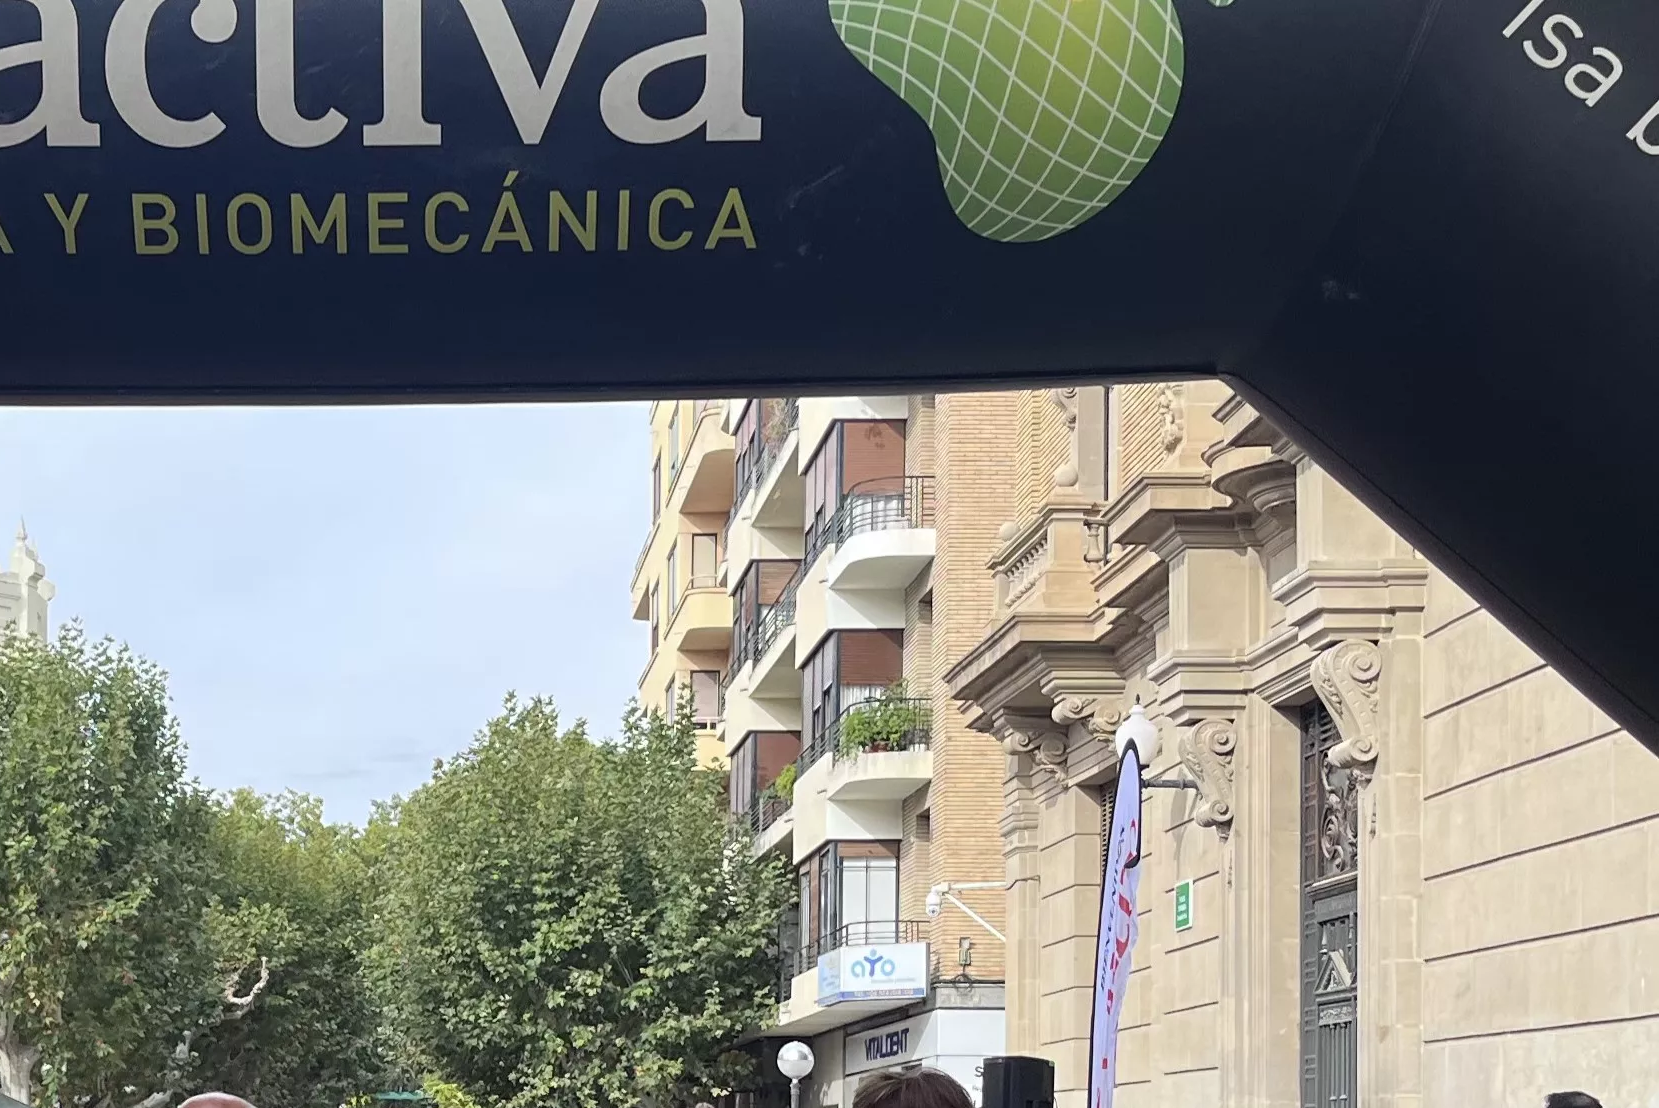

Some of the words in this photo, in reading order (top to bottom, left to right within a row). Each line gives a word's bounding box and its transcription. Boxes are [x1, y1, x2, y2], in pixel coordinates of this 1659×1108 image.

[43, 193, 90, 254] Y
[131, 170, 758, 256] BIOMECÁNICA
[864, 1028, 910, 1061] VITALDENT
